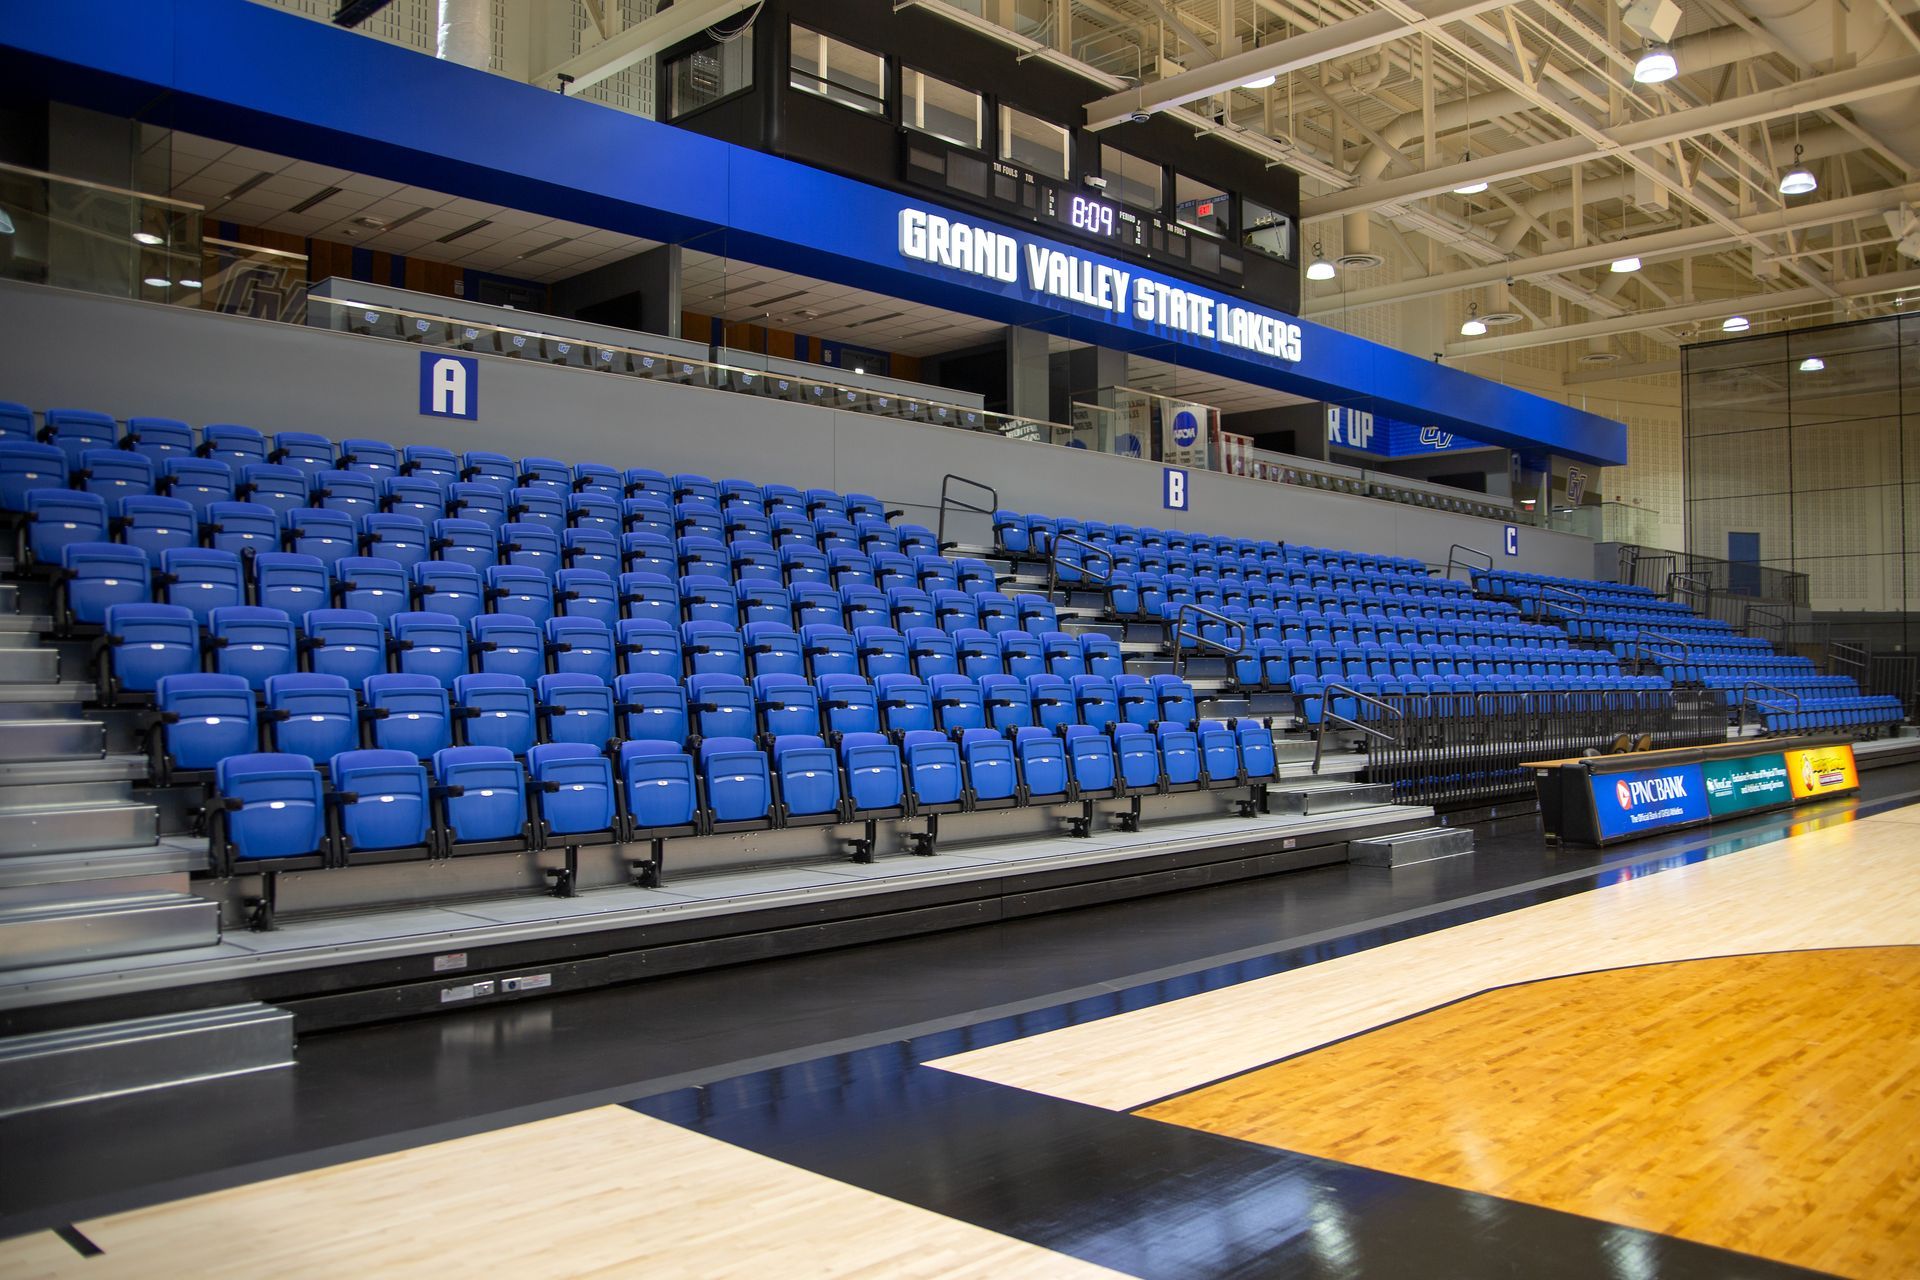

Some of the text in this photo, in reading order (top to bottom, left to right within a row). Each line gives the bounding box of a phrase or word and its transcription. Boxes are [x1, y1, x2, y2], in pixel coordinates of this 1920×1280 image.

[1002, 165, 1018, 178] FOULS
[1025, 173, 1034, 184] TOL
[1072, 196, 1113, 236] 8:09
[1119, 210, 1136, 224] PERIOD
[1174, 225, 1187, 237] FOULS
[900, 207, 1301, 363] GRAND VALLEY STATE LAKERS
[433, 358, 467, 416] A
[1347, 407, 1374, 449] UP
[1169, 470, 1184, 508] B
[1507, 527, 1516, 555] C
